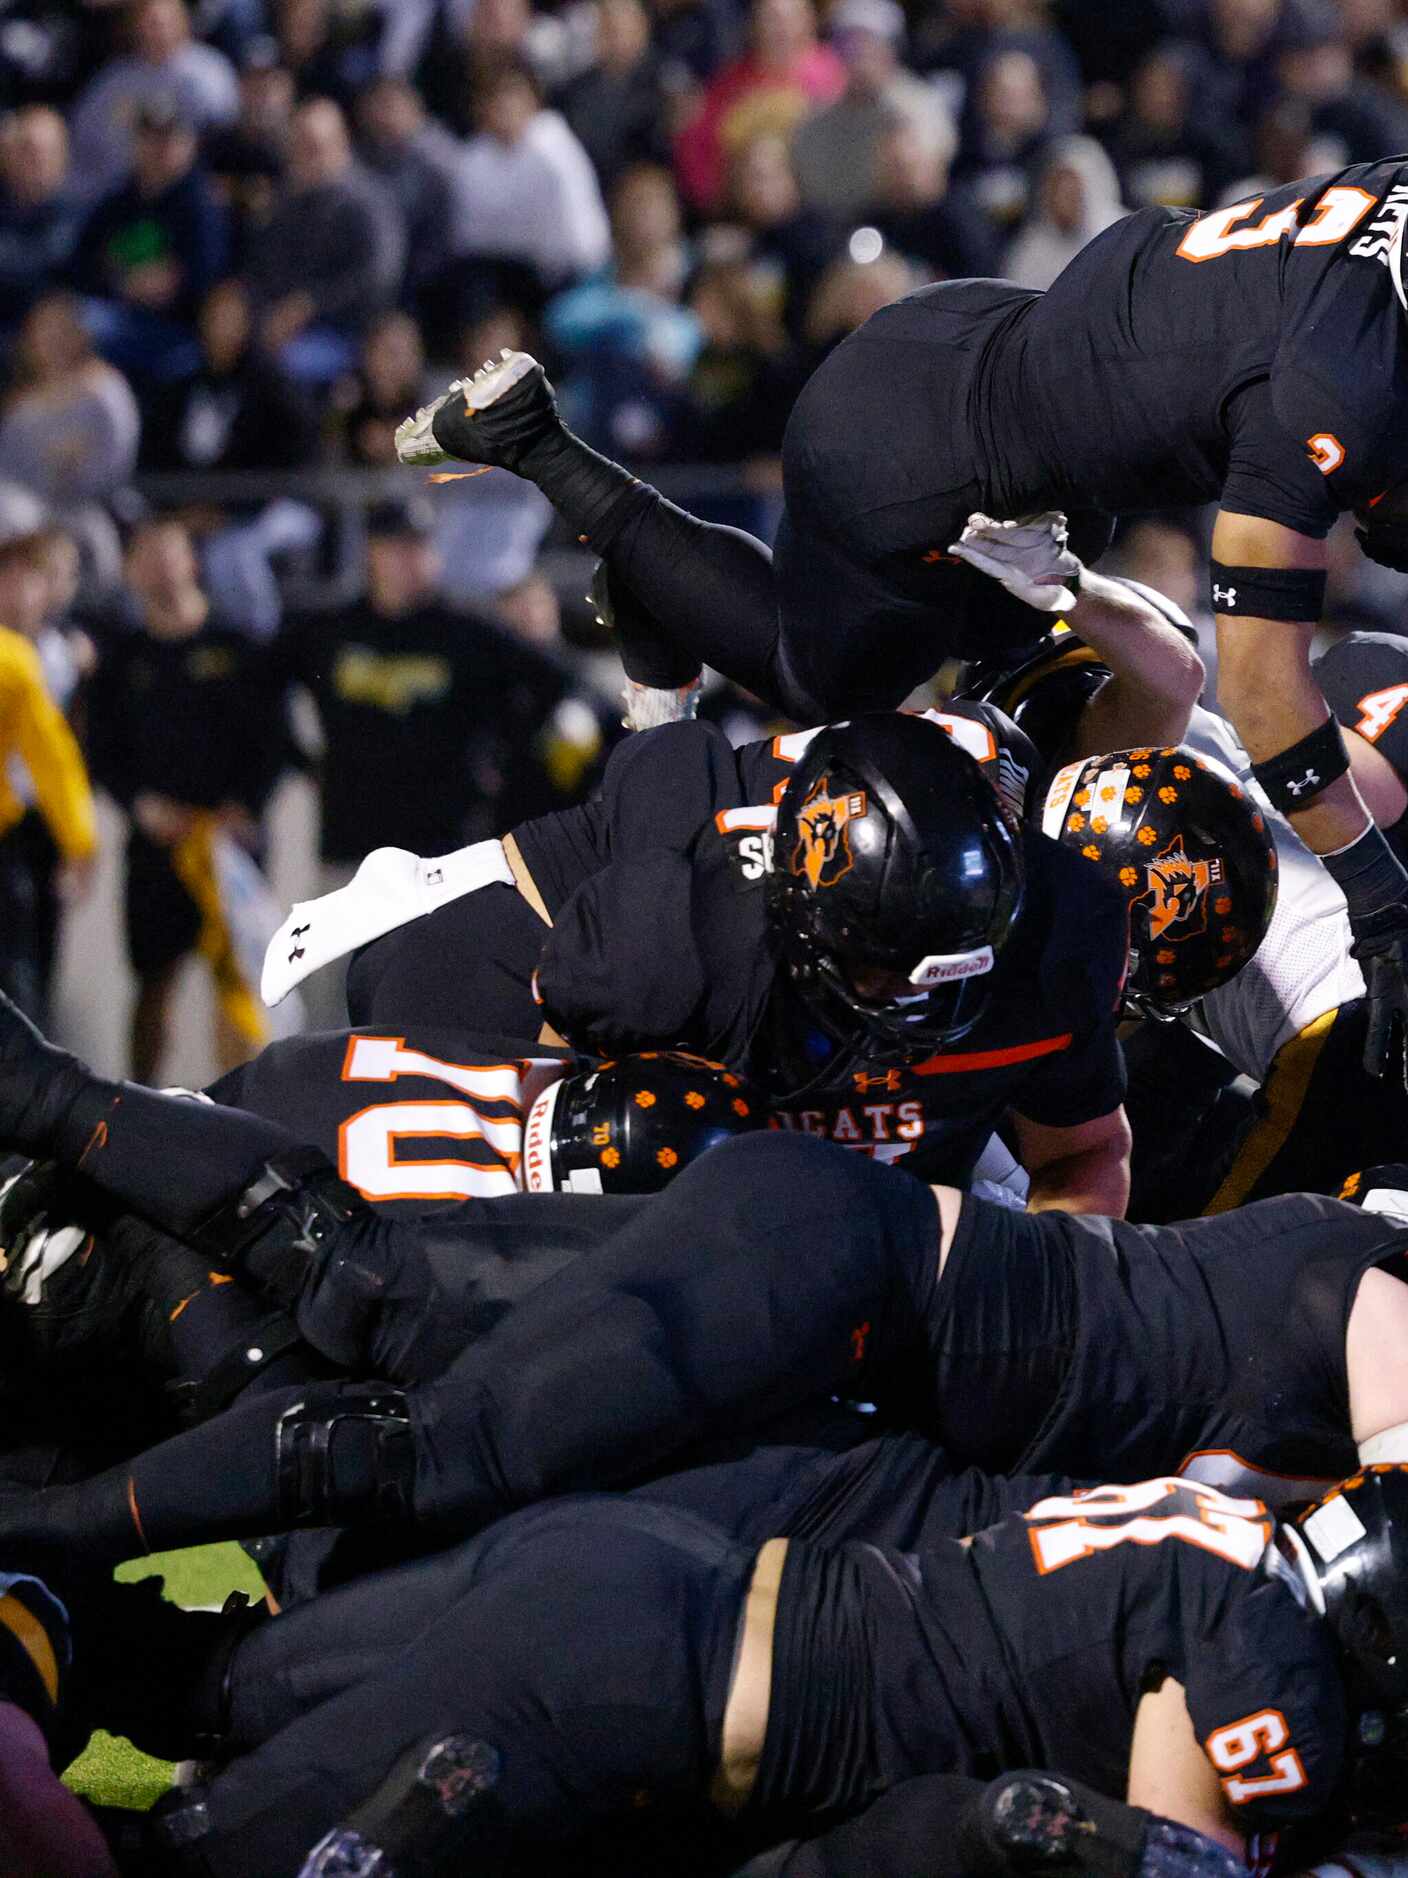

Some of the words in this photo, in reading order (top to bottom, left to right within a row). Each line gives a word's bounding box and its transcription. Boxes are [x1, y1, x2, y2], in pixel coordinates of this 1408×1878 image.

[1175, 186, 1378, 263] 3
[592, 1121, 611, 1146] 70
[1206, 1707, 1309, 1806] 67
